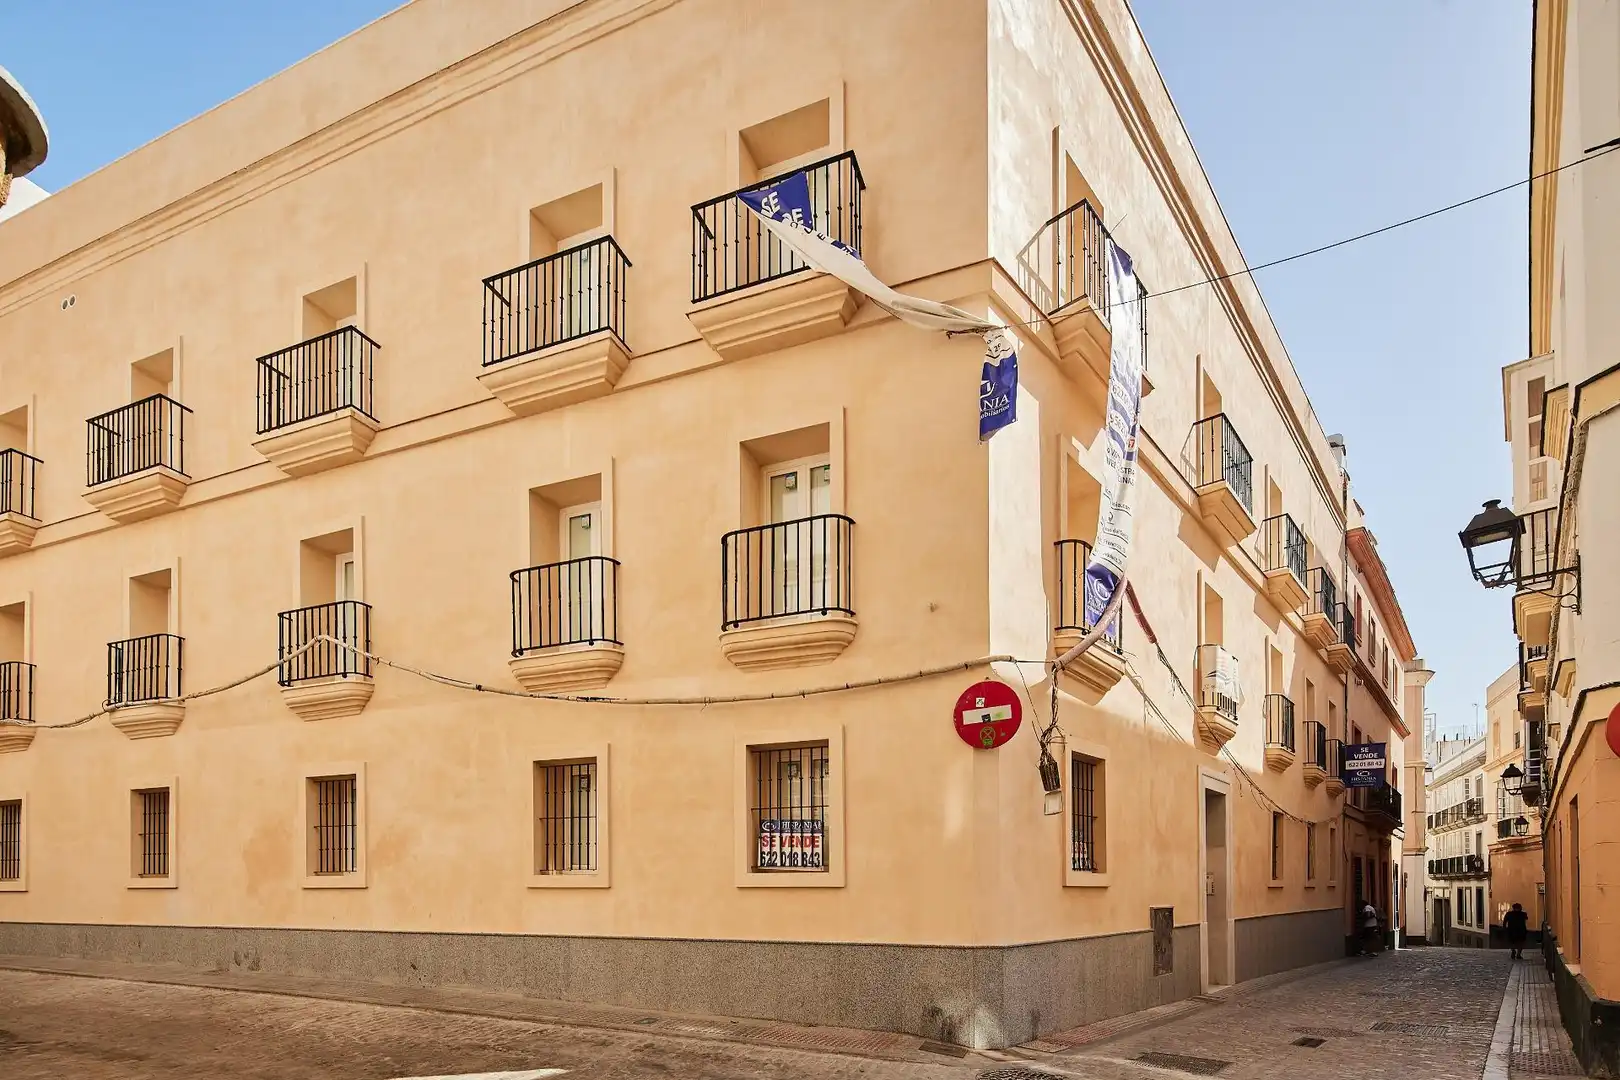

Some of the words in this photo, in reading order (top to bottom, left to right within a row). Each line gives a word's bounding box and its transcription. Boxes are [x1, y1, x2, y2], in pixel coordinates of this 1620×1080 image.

[760, 191, 781, 219] SE
[762, 834, 777, 848] SE
[781, 834, 820, 848] VENDE
[760, 850, 778, 867] 622
[780, 851, 799, 867] 018
